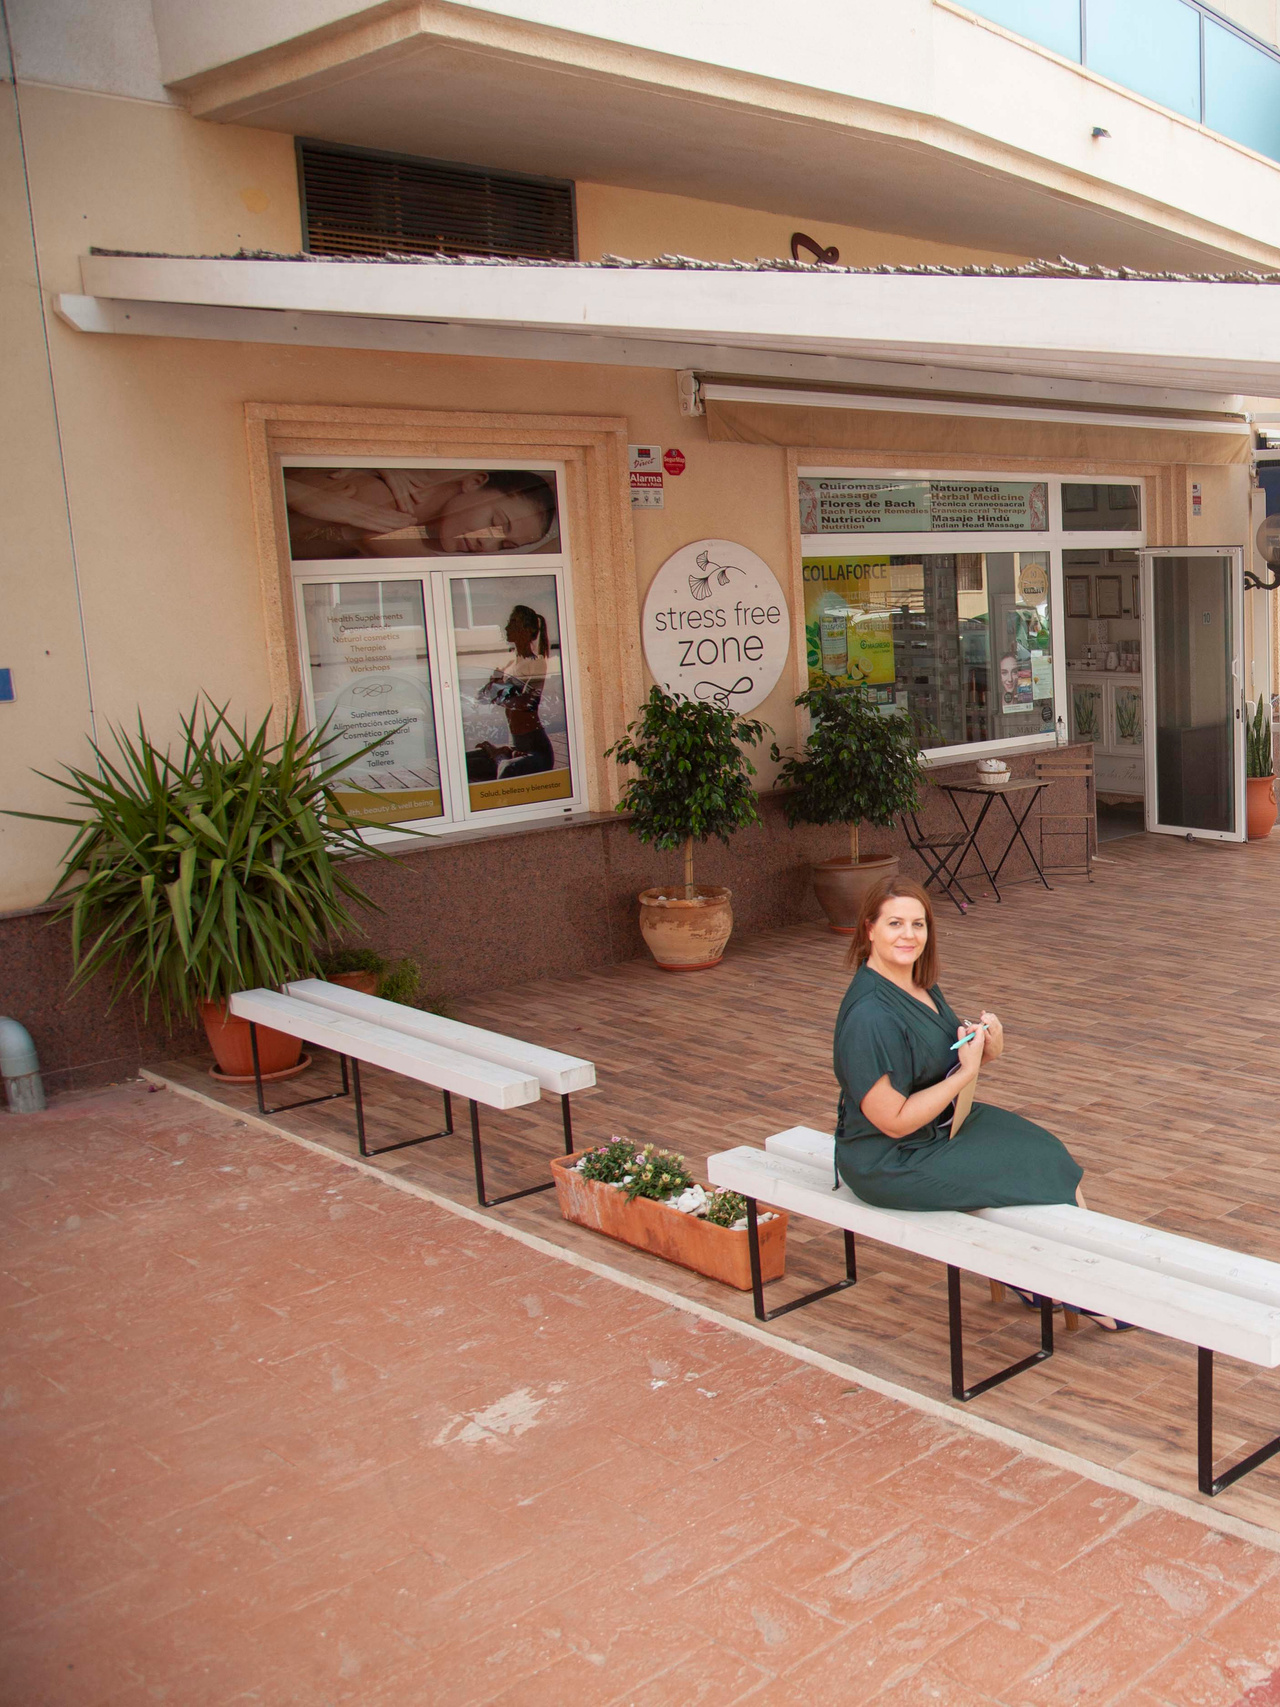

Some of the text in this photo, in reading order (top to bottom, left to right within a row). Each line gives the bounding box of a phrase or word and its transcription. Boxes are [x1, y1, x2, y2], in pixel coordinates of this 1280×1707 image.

[630, 473, 662, 483] Alarma
[820, 492, 878, 500] Massage
[931, 493, 970, 501] Herbal
[820, 500, 916, 508] Flores de Bach
[932, 515, 974, 523] Masaje
[802, 563, 888, 581] COLLAFORCE
[327, 614, 353, 624] Health
[655, 601, 781, 632] stress free
[1203, 612, 1210, 624] 10
[332, 633, 400, 643] Natural cosmetics
[350, 645, 387, 654] Therapies
[678, 635, 764, 667] zone
[344, 654, 392, 664] Yoga lessons
[349, 664, 390, 673] Workshops
[351, 709, 399, 719] Suplementos
[333, 716, 417, 731] Alimentación ecológica
[343, 727, 410, 740] Cosmética naural
[370, 750, 389, 758] Yoga
[367, 759, 394, 768] Talleres
[480, 790, 500, 799] Salud,
[502, 787, 525, 796] belleza
[531, 783, 561, 792] bienestar
[364, 803, 389, 815] beauty
[414, 799, 434, 810] being
